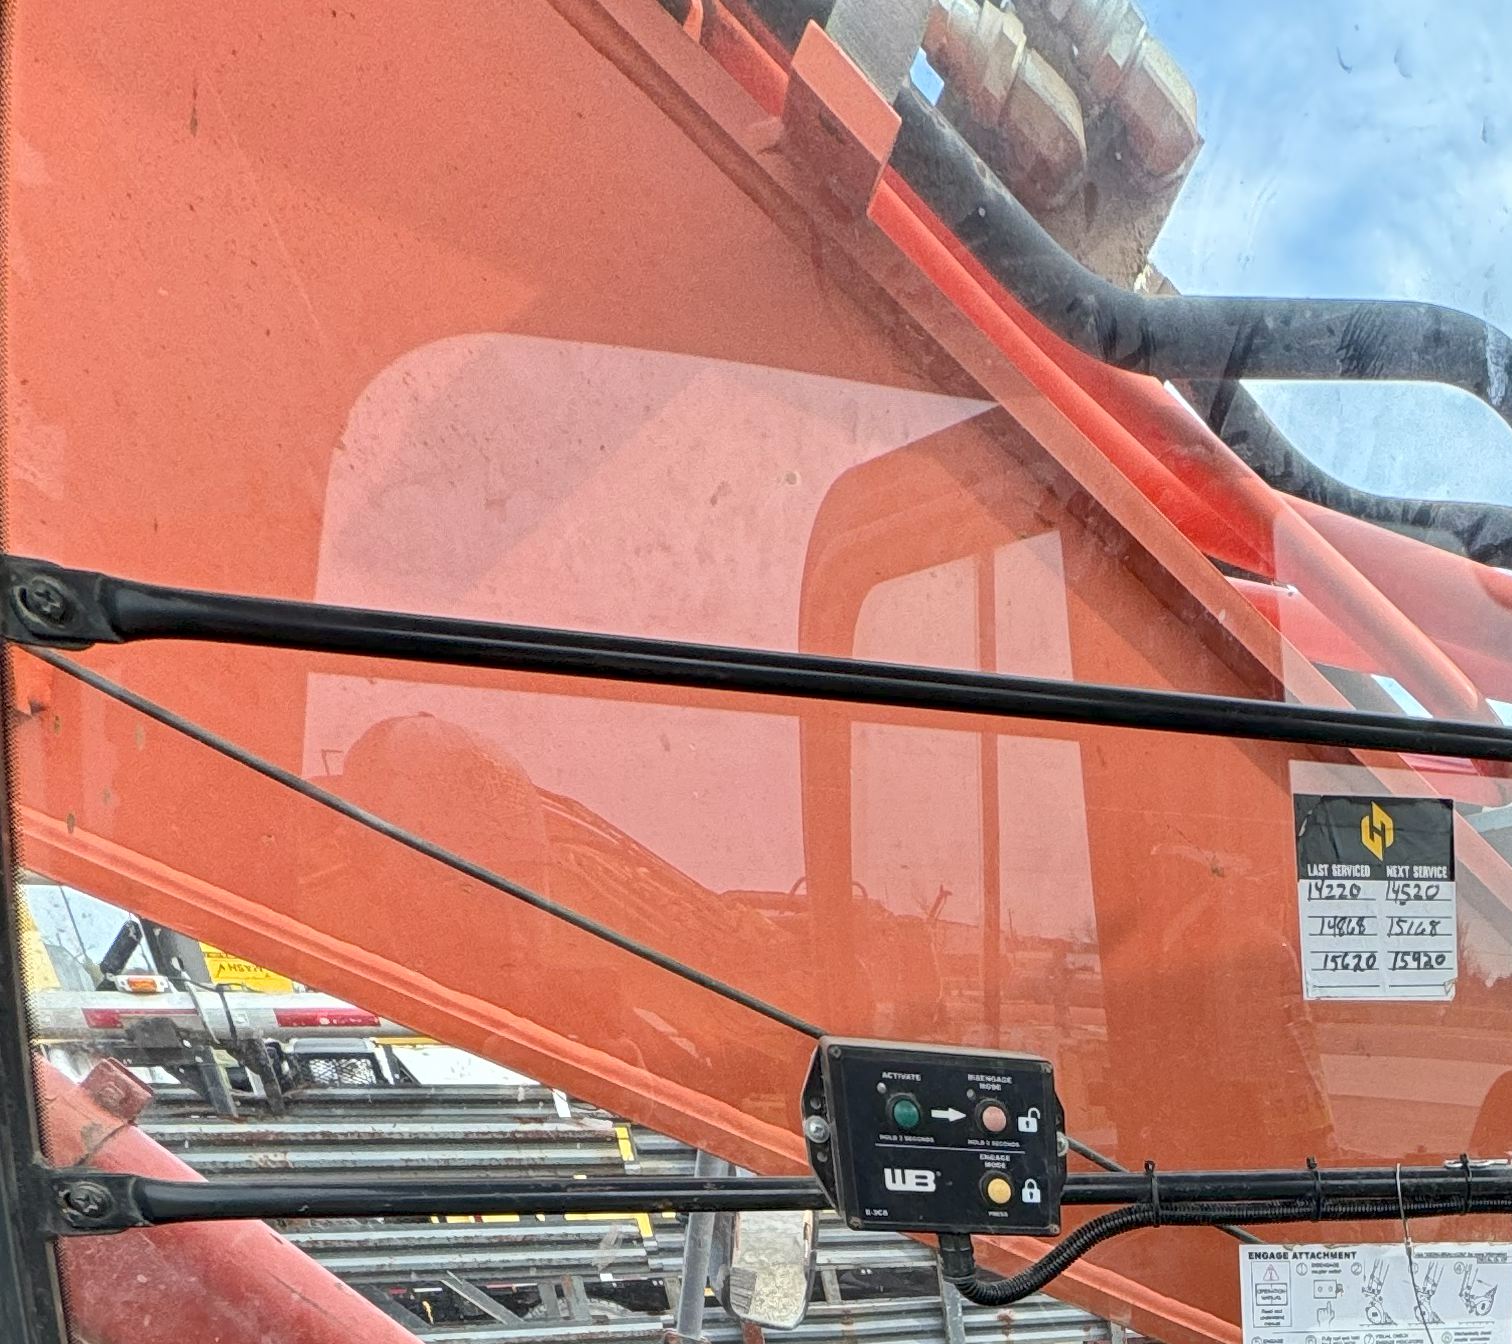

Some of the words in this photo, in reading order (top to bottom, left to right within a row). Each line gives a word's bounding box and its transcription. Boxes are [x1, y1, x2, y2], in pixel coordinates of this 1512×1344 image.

[1307, 863, 1329, 877] LAST
[1332, 864, 1371, 878] SERVICED
[1386, 865, 1410, 878] NEXT
[1413, 865, 1448, 879] SERVICE
[1307, 881, 1362, 900] 14220
[1392, 952, 1446, 971] 15920
[882, 1071, 921, 1081] ACTIVATE
[1248, 1251, 1289, 1260] ENGAGE
[1291, 1251, 1358, 1260] ATTACHMENT
